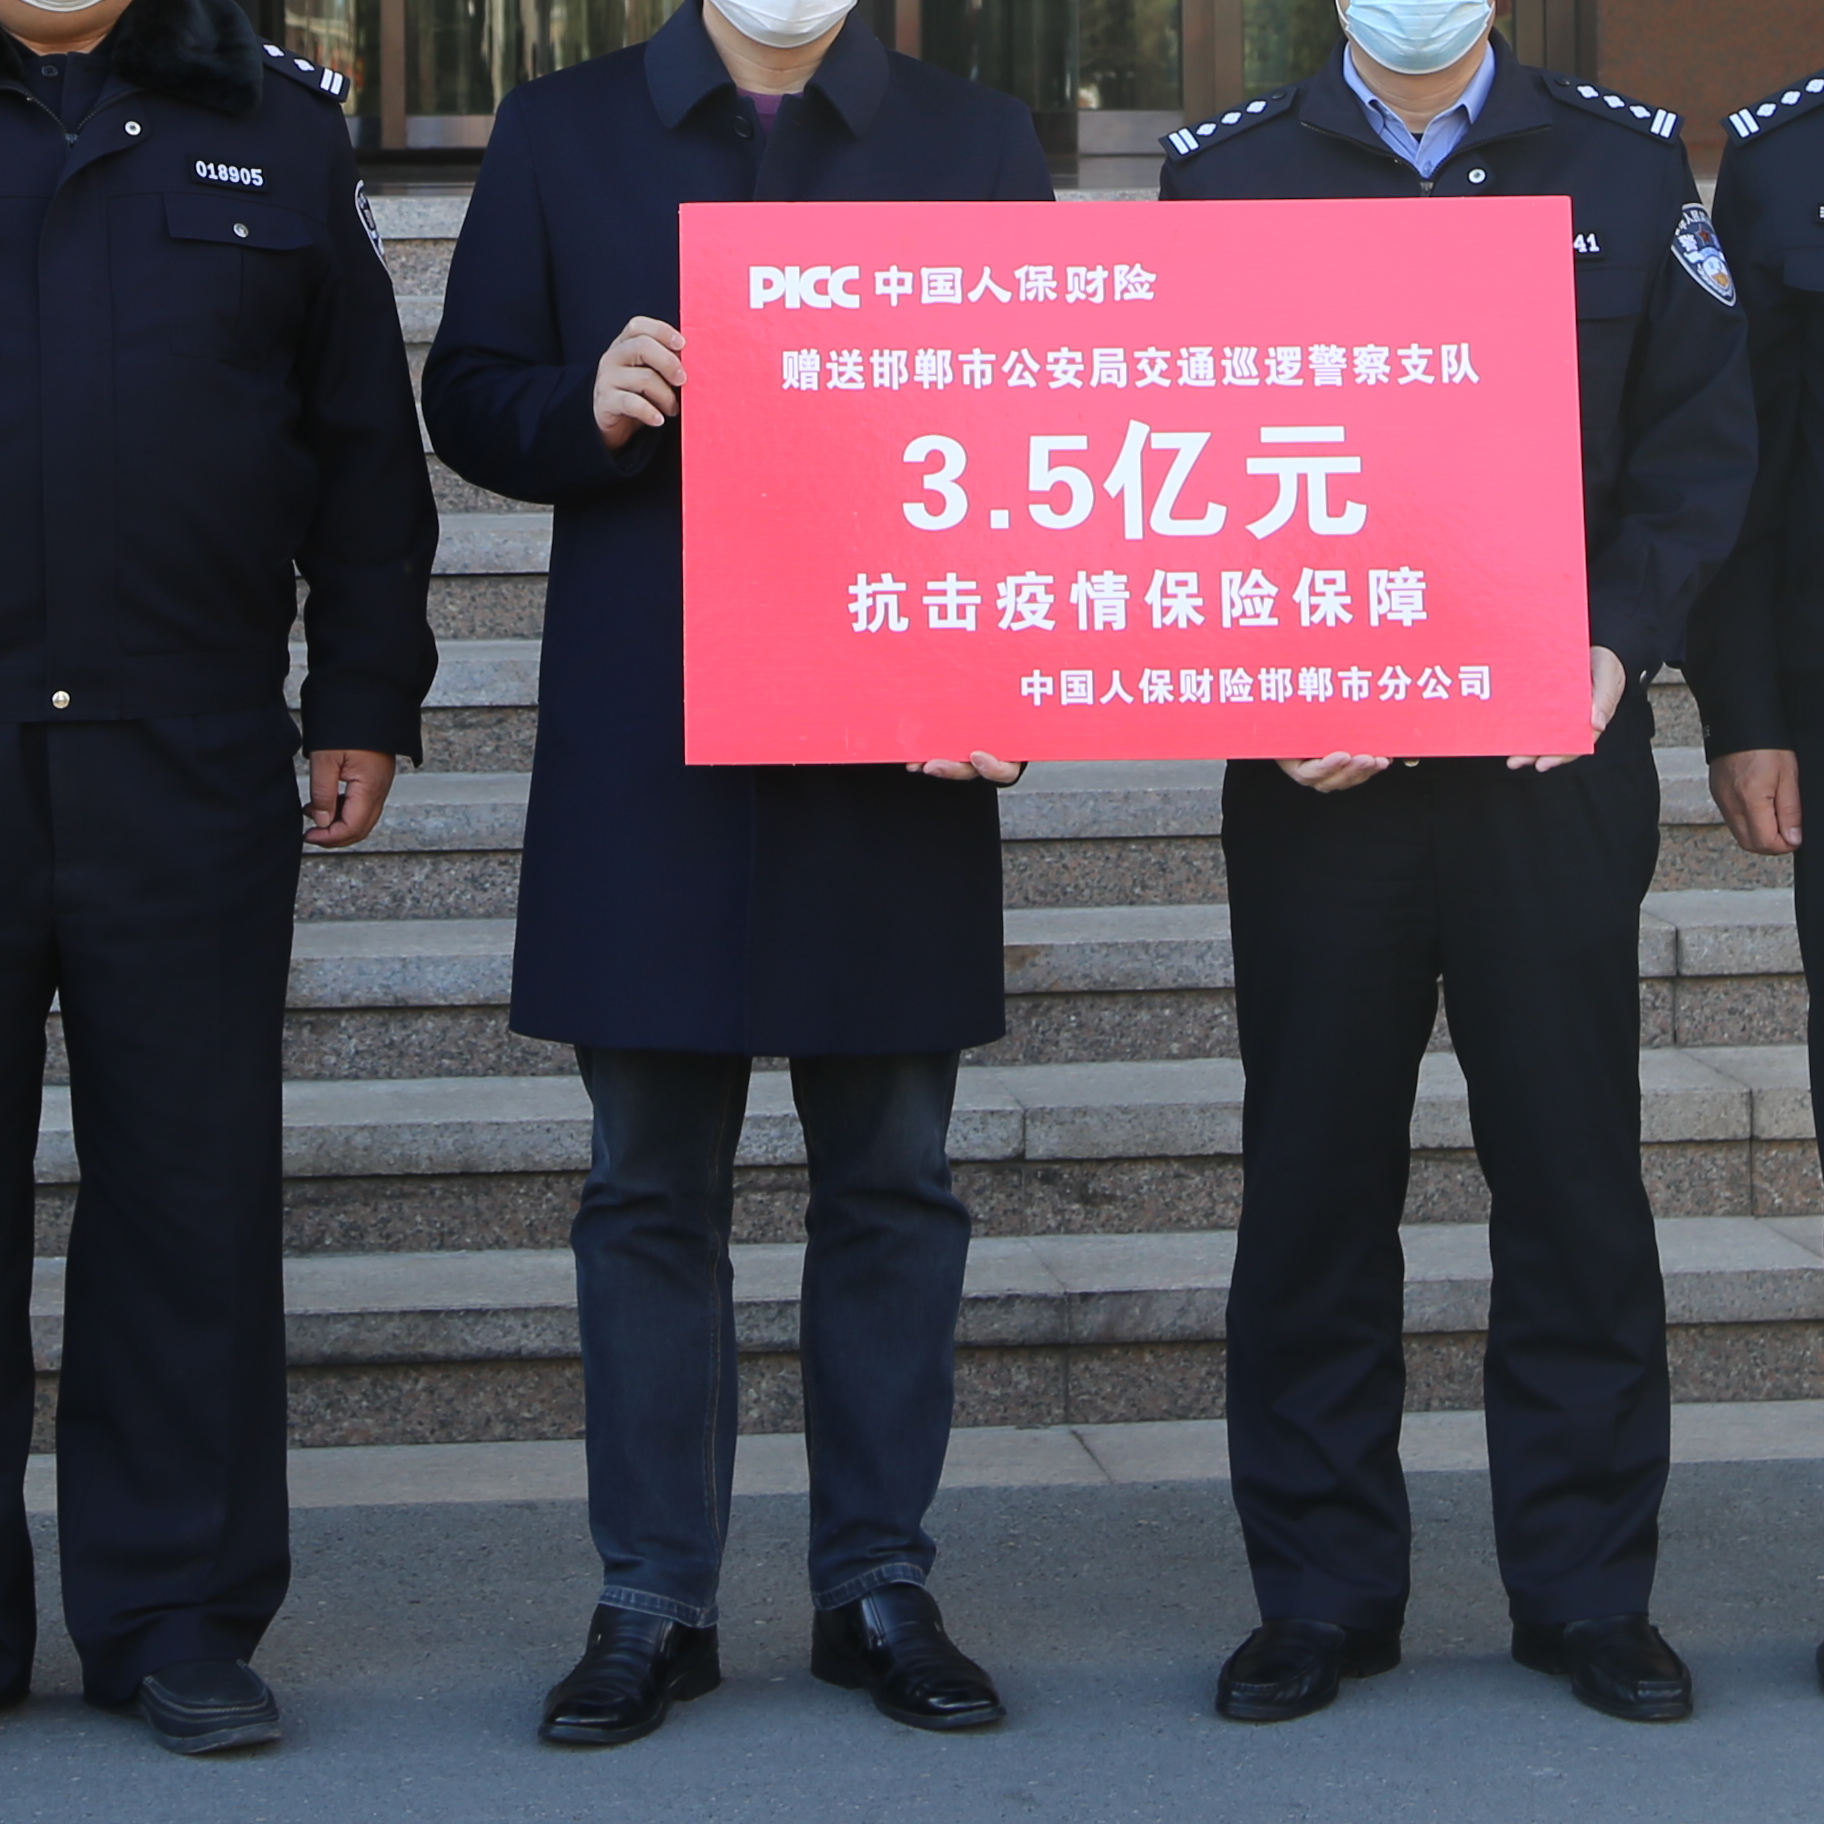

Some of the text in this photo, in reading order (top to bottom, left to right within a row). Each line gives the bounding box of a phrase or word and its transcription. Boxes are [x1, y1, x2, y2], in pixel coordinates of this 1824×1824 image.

[195, 160, 265, 187] 018905
[749, 262, 1157, 309] PICC 中国人保财险
[781, 342, 1480, 391] 赠送邯郸市公安局交通巡逻警察支队
[902, 419, 1368, 540] 3.5亿元
[847, 565, 1429, 633] 抗击疫情保险保障
[1020, 665, 1491, 706] 中国人保财险邯郸市分公司
